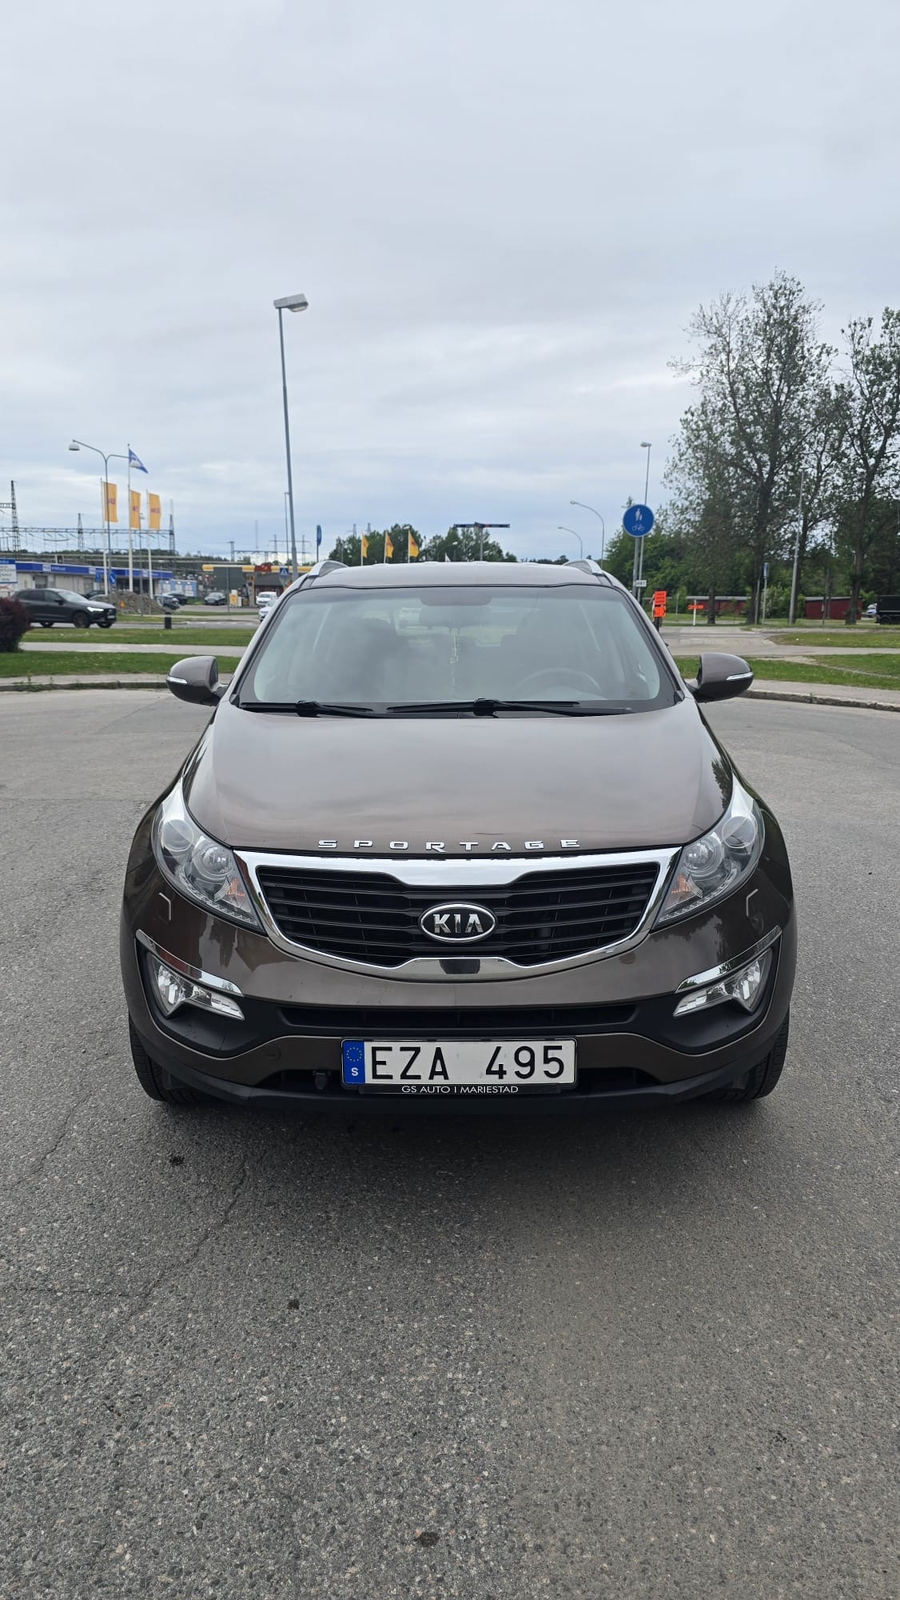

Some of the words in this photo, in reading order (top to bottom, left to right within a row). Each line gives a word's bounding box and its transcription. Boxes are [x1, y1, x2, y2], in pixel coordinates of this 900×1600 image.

[317, 839, 580, 852] SPORTAGE
[432, 913, 484, 934] KIA
[371, 1046, 450, 1081] EZA
[485, 1045, 565, 1080] 495
[351, 1067, 359, 1077] S
[401, 1085, 418, 1094] GS
[419, 1085, 451, 1094] AUTO
[459, 1085, 519, 1094] MARIESTAD
